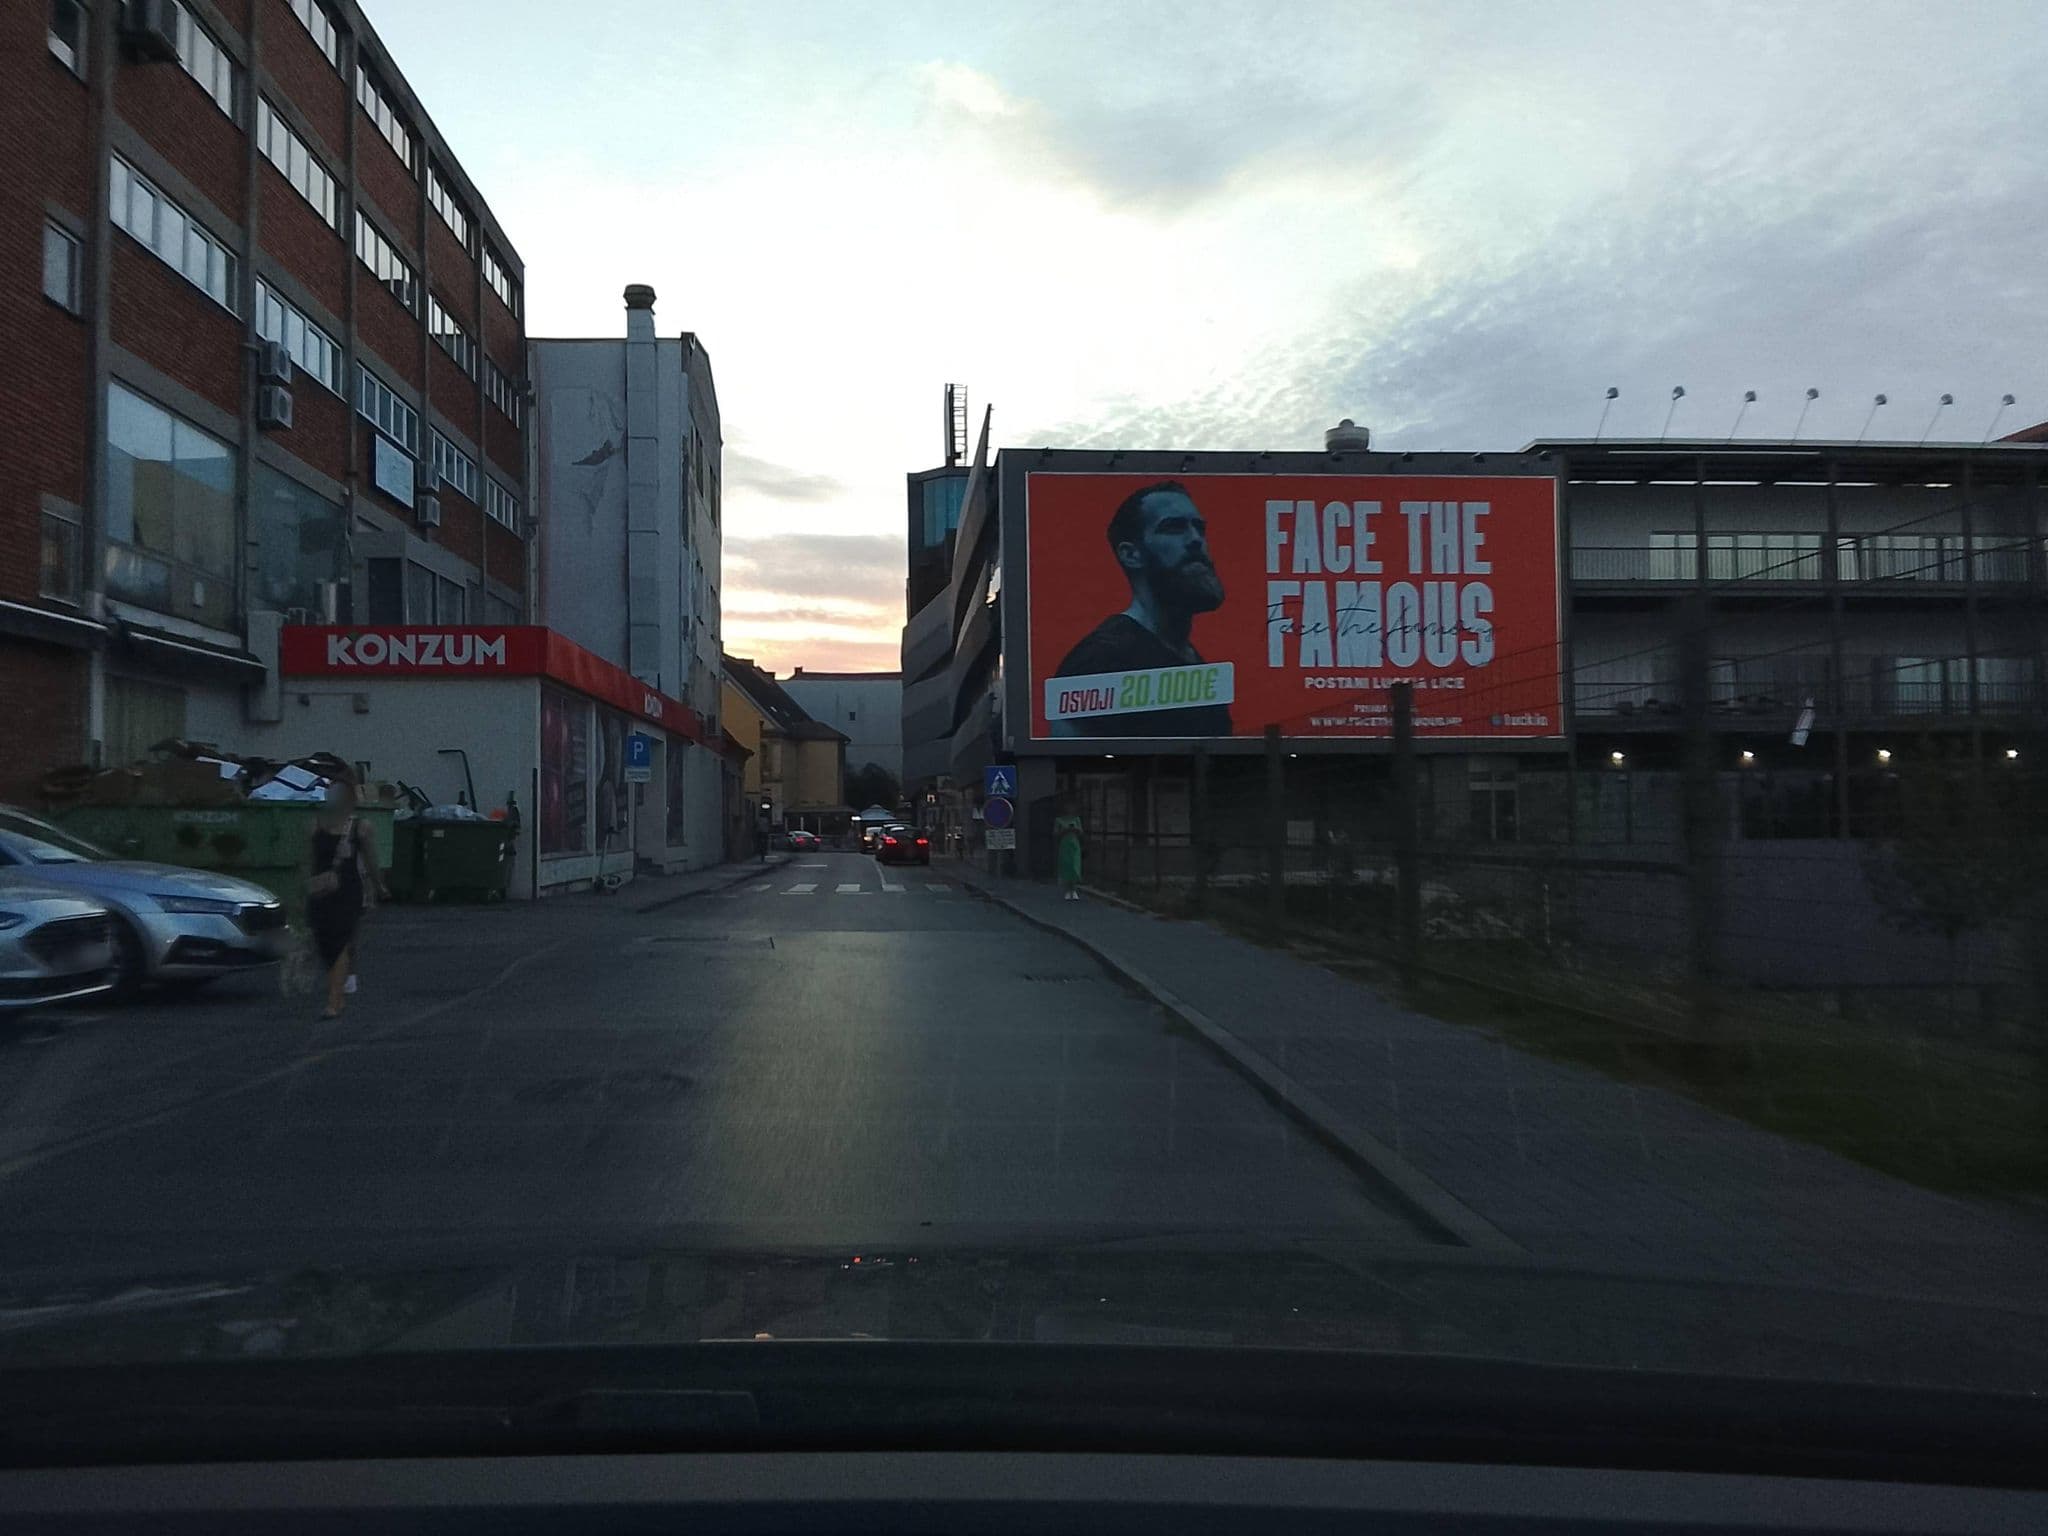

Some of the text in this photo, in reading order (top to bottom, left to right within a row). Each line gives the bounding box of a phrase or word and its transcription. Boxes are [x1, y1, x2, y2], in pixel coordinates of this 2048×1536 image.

[1266, 500, 1492, 575] FACE THE
[1268, 581, 1496, 669] FAMOUS
[327, 633, 507, 666] KONZUM
[1059, 669, 1217, 714] OSVOJI 20.000€
[1304, 677, 1370, 689] POSTANI
[1431, 677, 1465, 689] LICE
[633, 741, 644, 760] P
